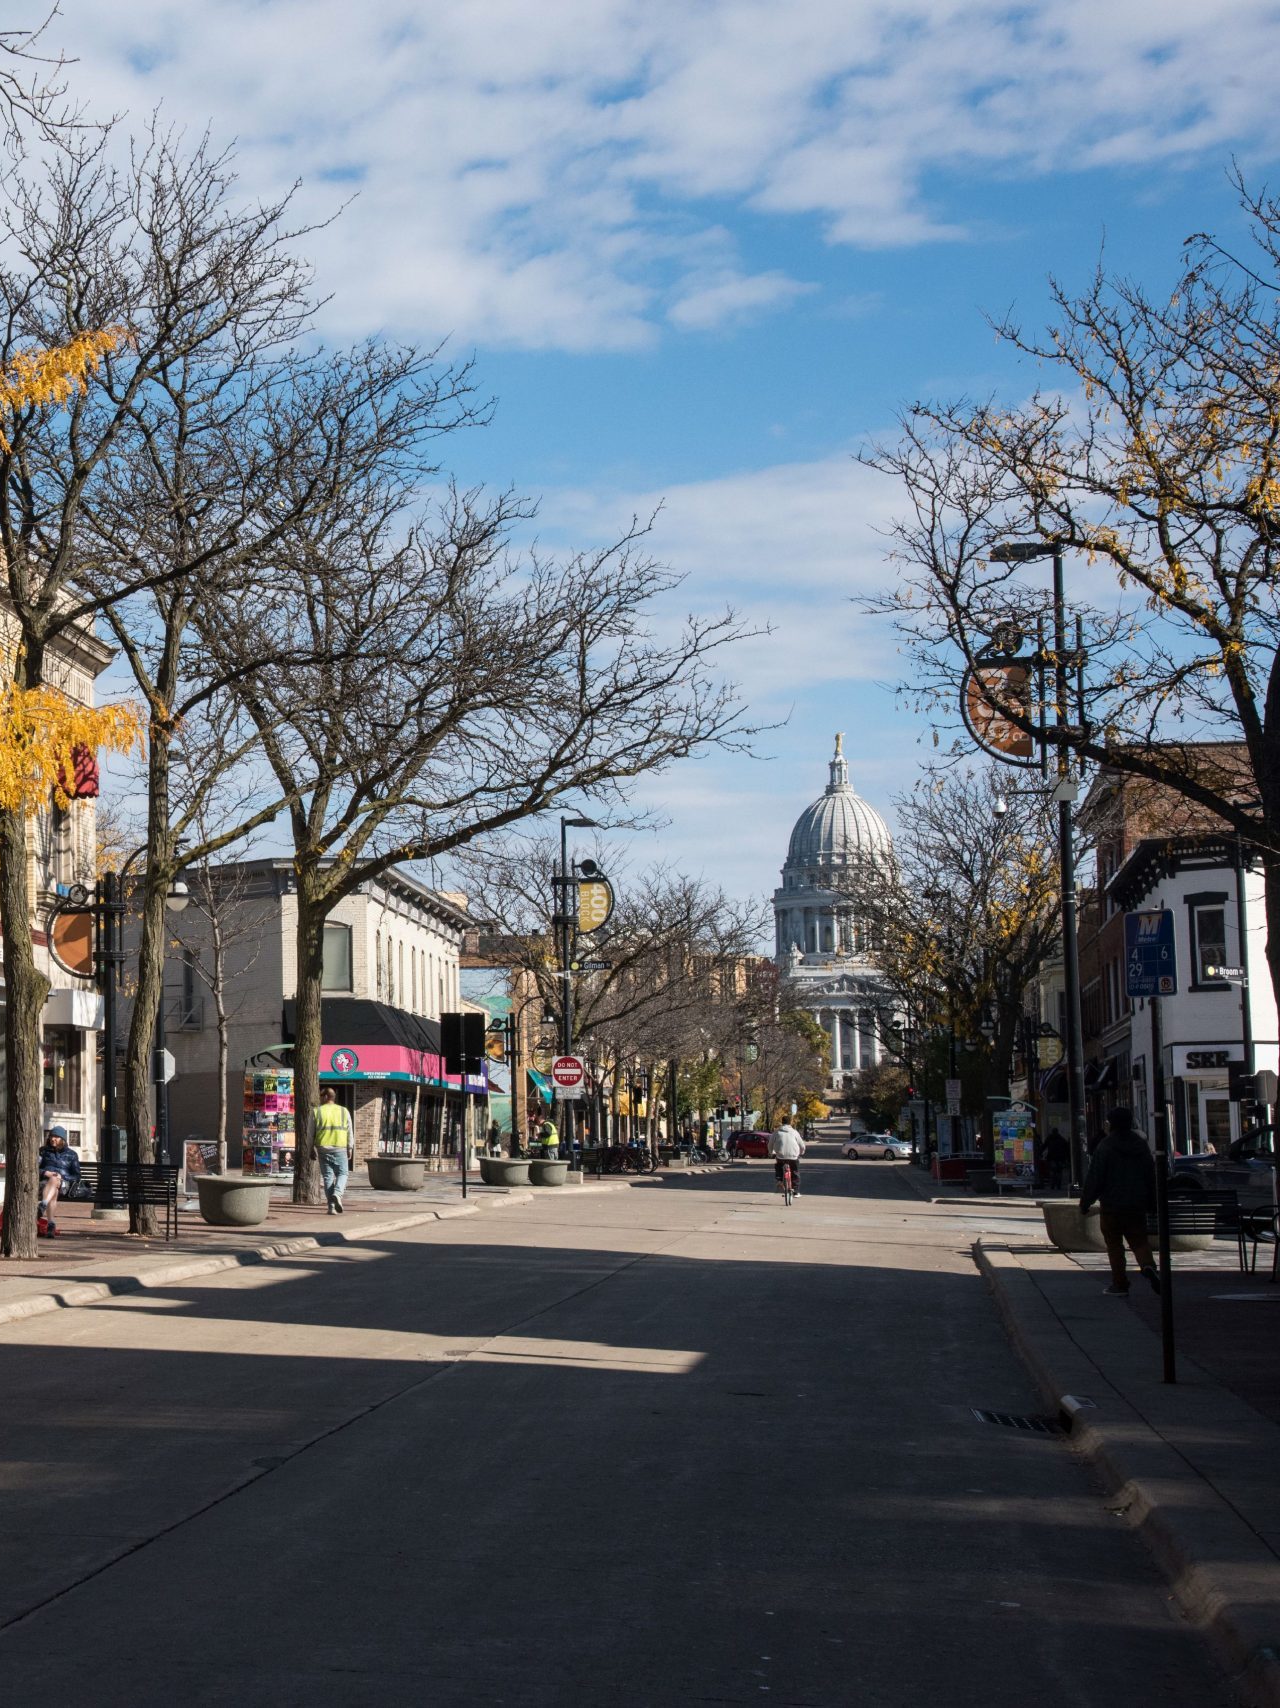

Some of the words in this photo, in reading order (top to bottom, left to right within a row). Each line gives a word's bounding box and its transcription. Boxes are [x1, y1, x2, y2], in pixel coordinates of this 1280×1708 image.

[581, 890, 590, 922] BLOCK
[591, 883, 608, 922] 400
[1131, 948, 1139, 961] 4
[1161, 946, 1168, 960] 6
[1129, 963, 1143, 977] 29
[1219, 966, 1239, 976] Broom
[1186, 1050, 1229, 1069] SEE
